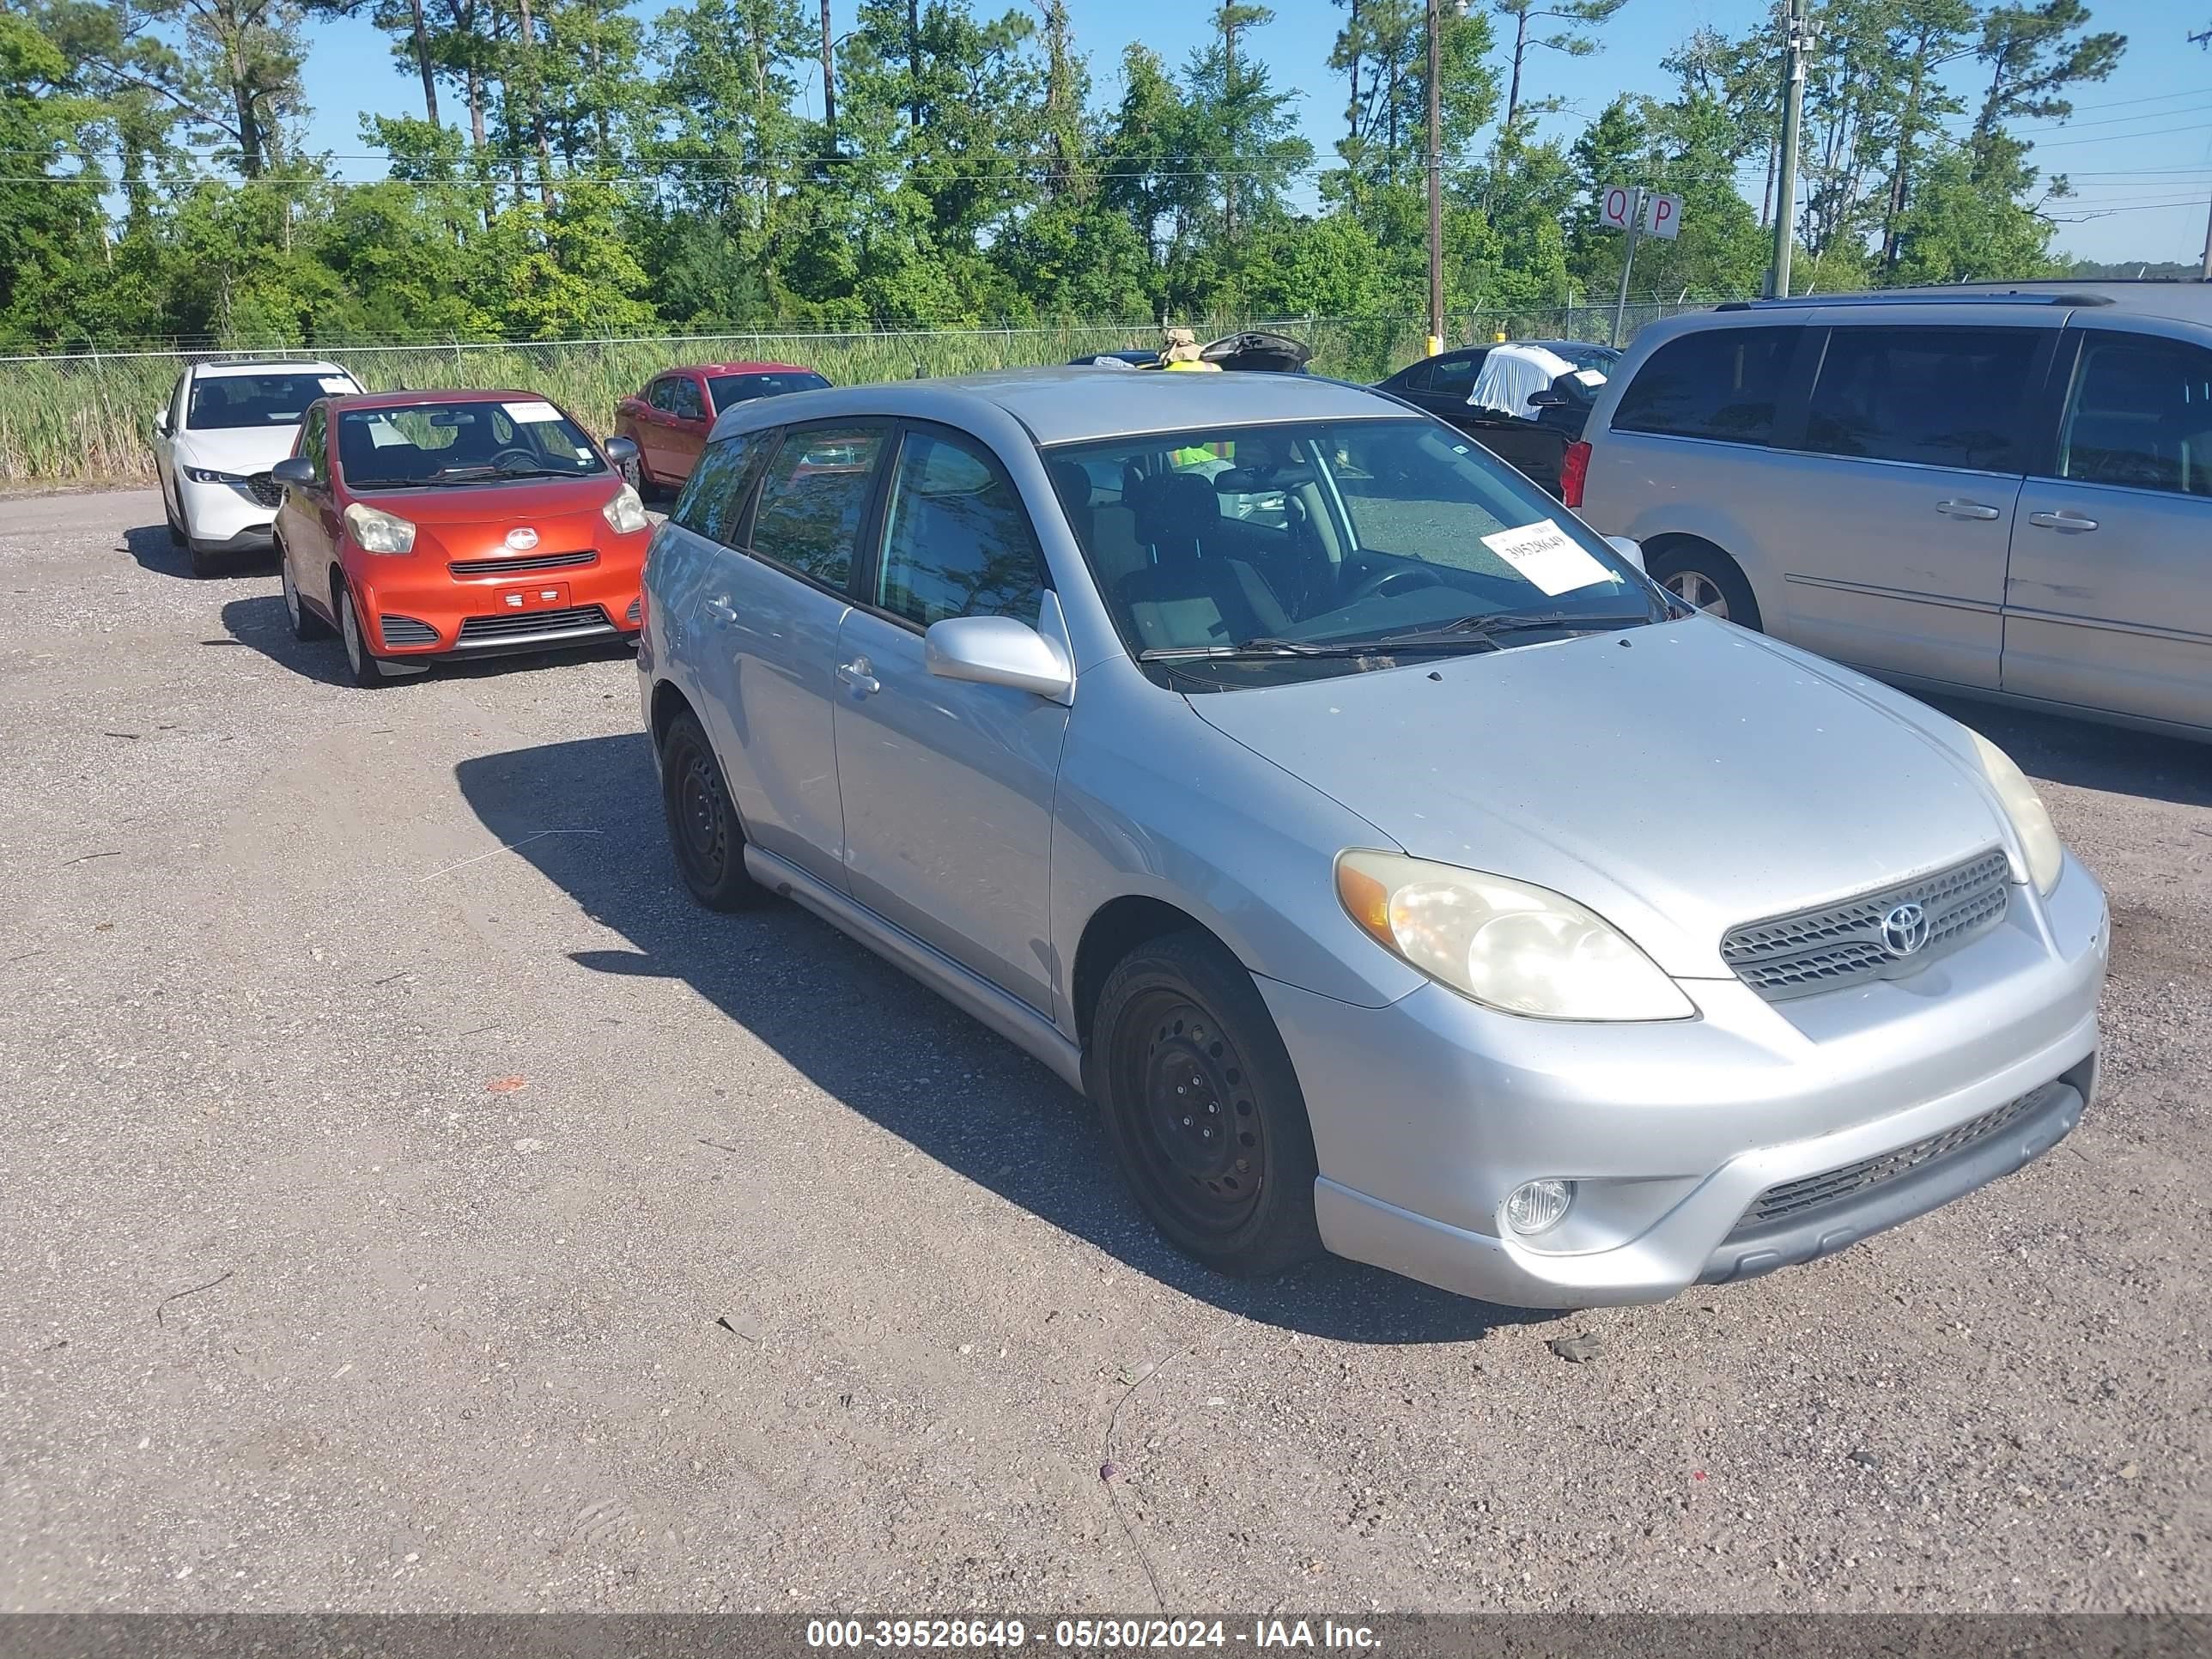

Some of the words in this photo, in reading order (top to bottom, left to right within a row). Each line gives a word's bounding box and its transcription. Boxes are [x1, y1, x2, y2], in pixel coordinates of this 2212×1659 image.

[1607, 190, 1626, 225] Q
[1655, 200, 1672, 230] P
[1504, 535, 1565, 559] 39528649
